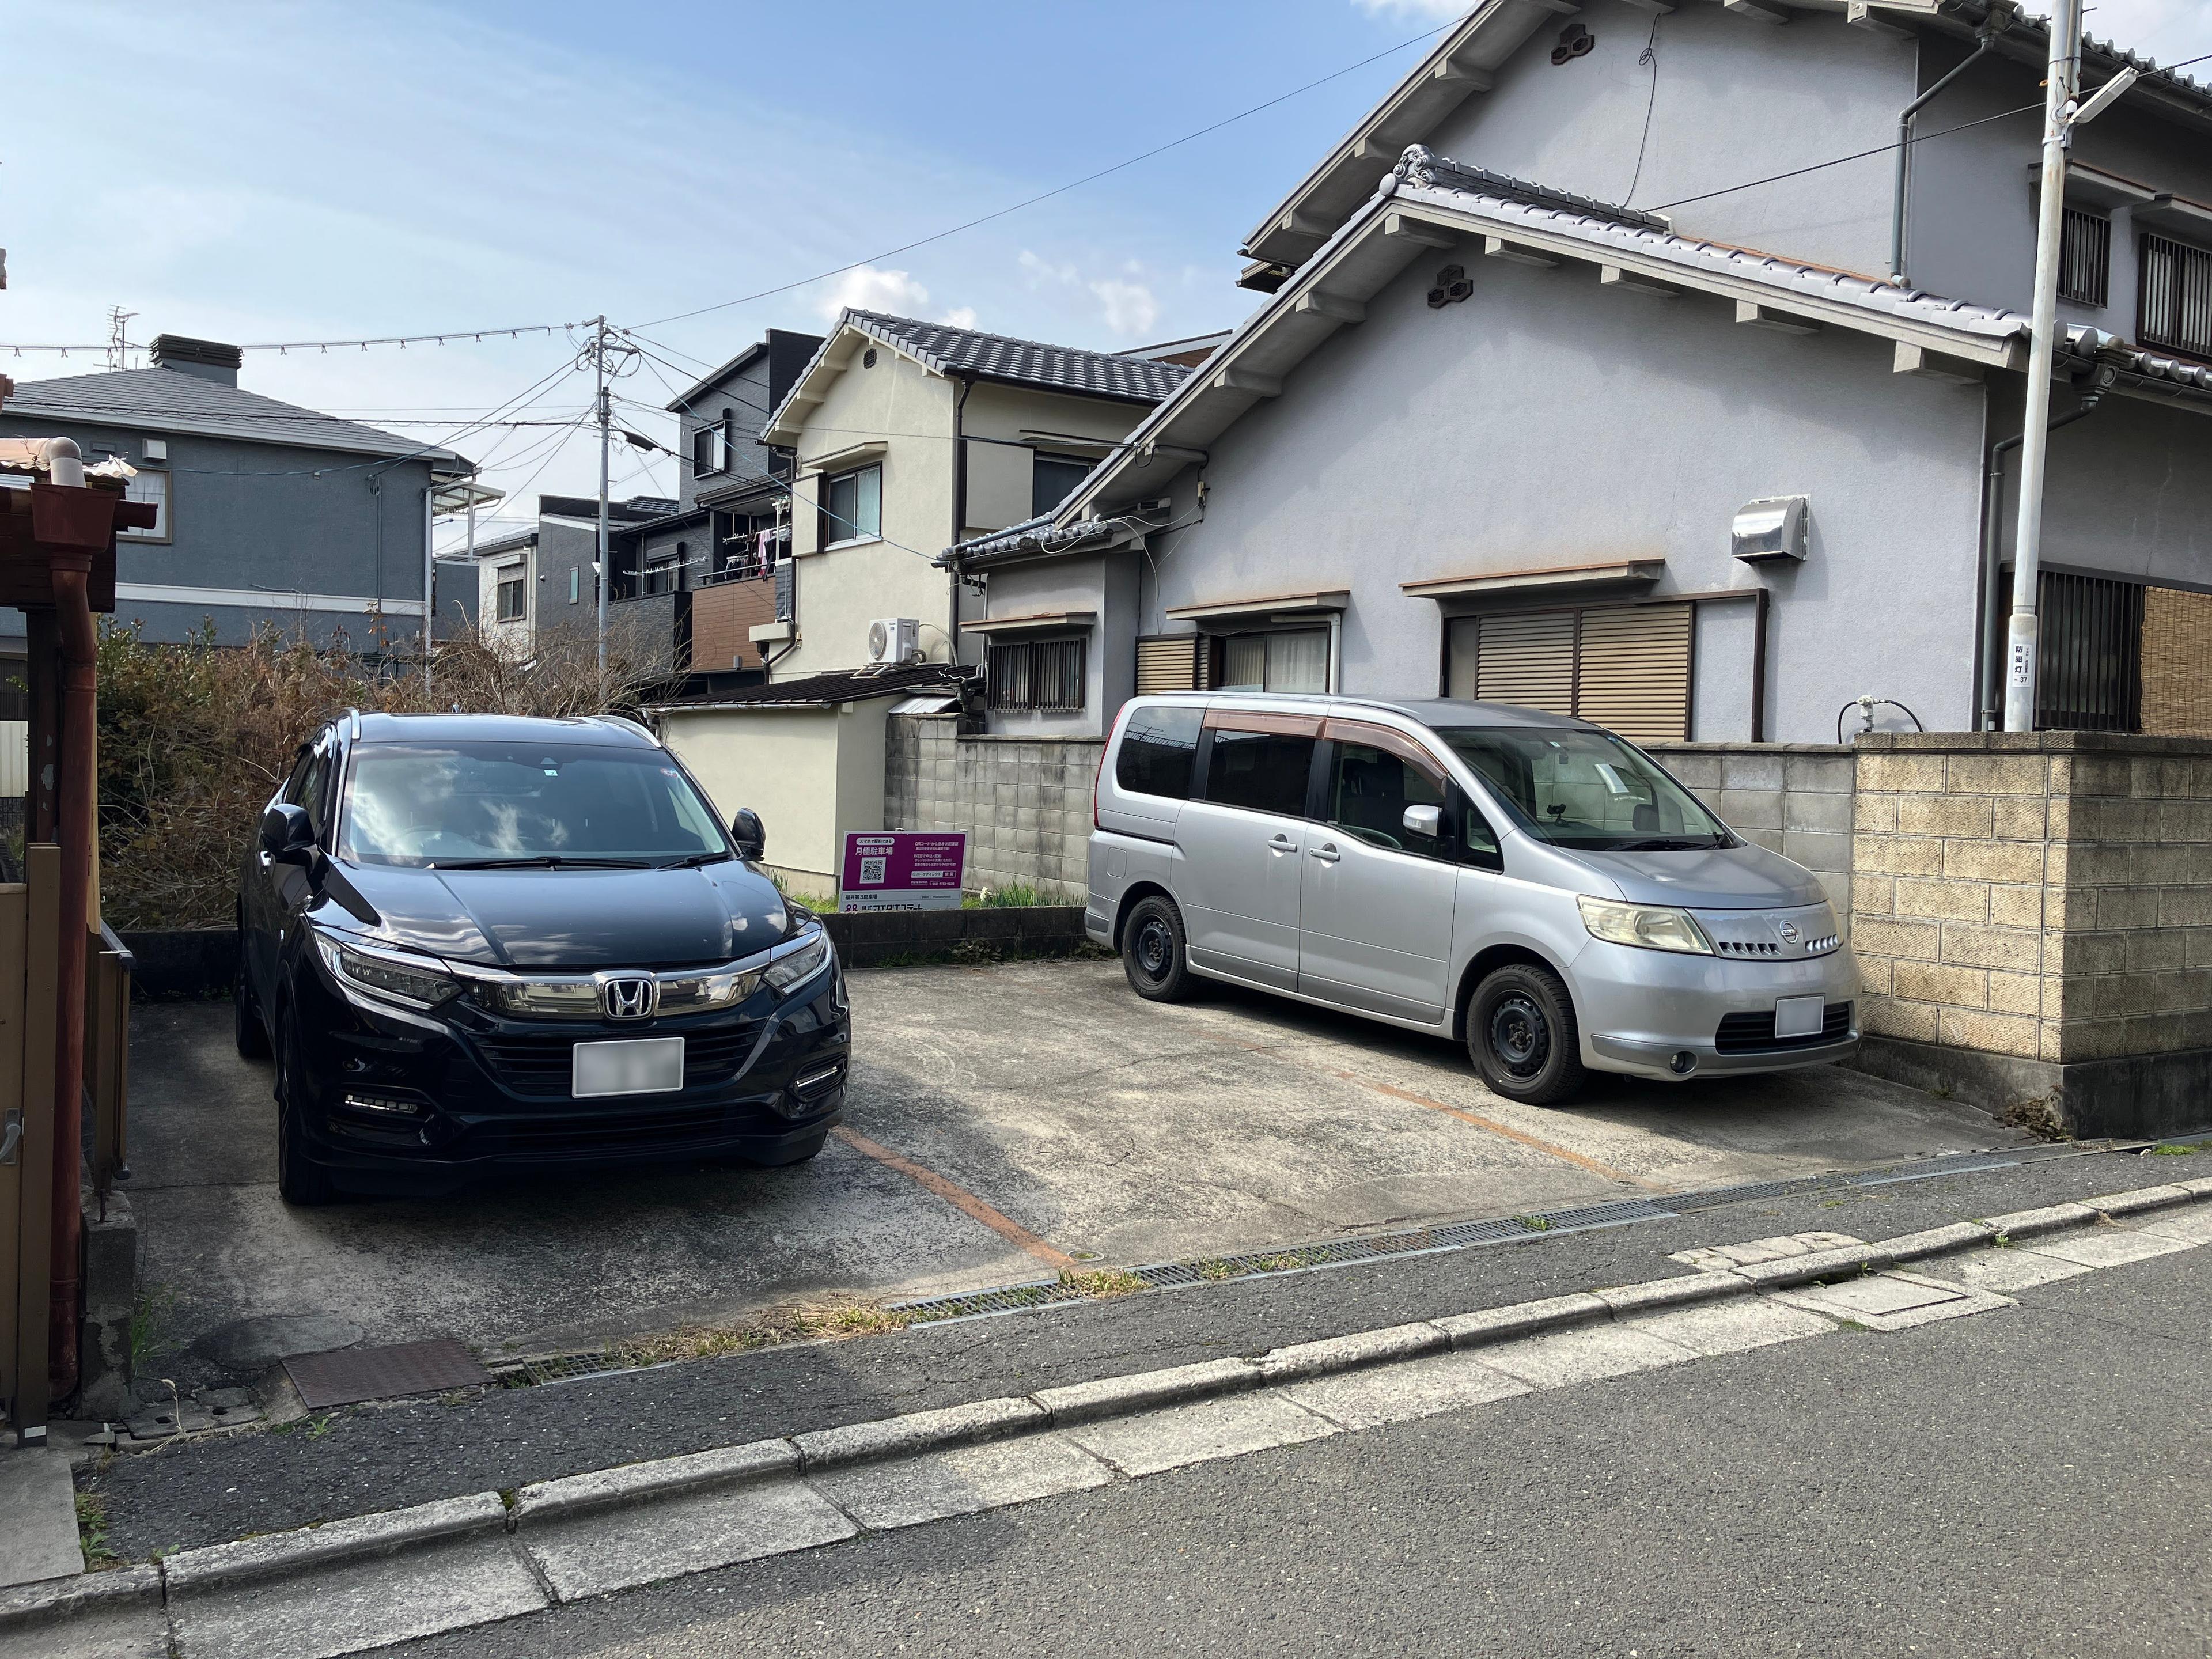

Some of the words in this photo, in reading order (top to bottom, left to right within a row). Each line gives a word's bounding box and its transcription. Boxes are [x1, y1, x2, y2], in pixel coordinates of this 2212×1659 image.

[2014, 646, 2023, 673] 防犯灯
[855, 847, 893, 855] 月極駐車場
